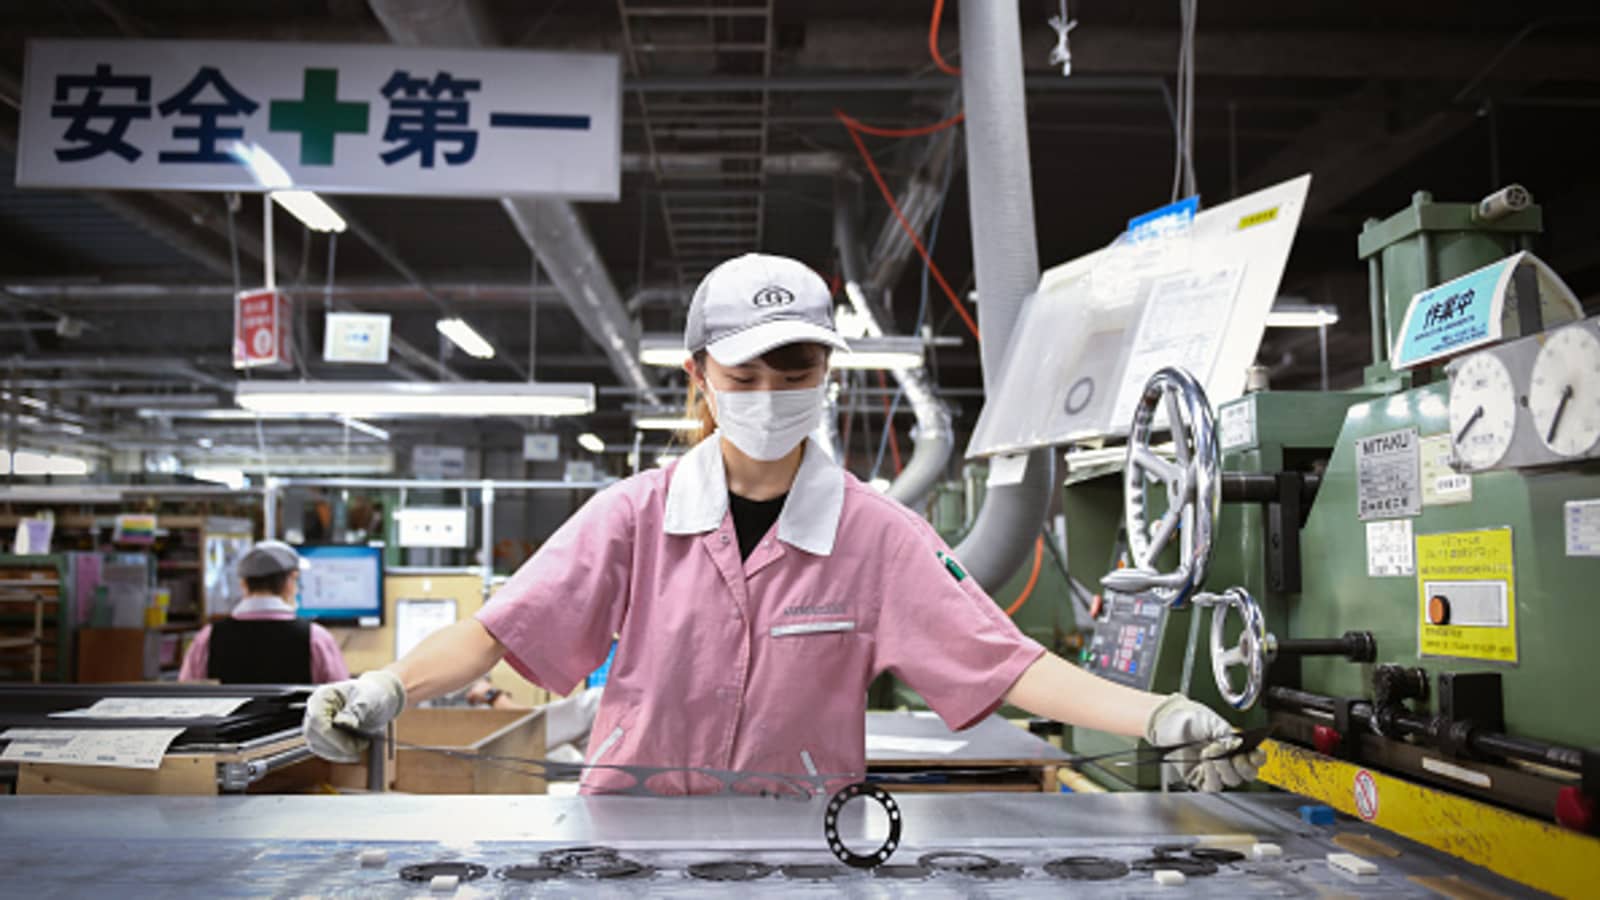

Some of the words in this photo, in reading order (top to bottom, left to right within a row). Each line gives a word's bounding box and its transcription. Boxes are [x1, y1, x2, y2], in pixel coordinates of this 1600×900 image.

[50, 63, 261, 165] 安全
[379, 69, 591, 169] 第一
[1362, 432, 1411, 456] MITAKU
